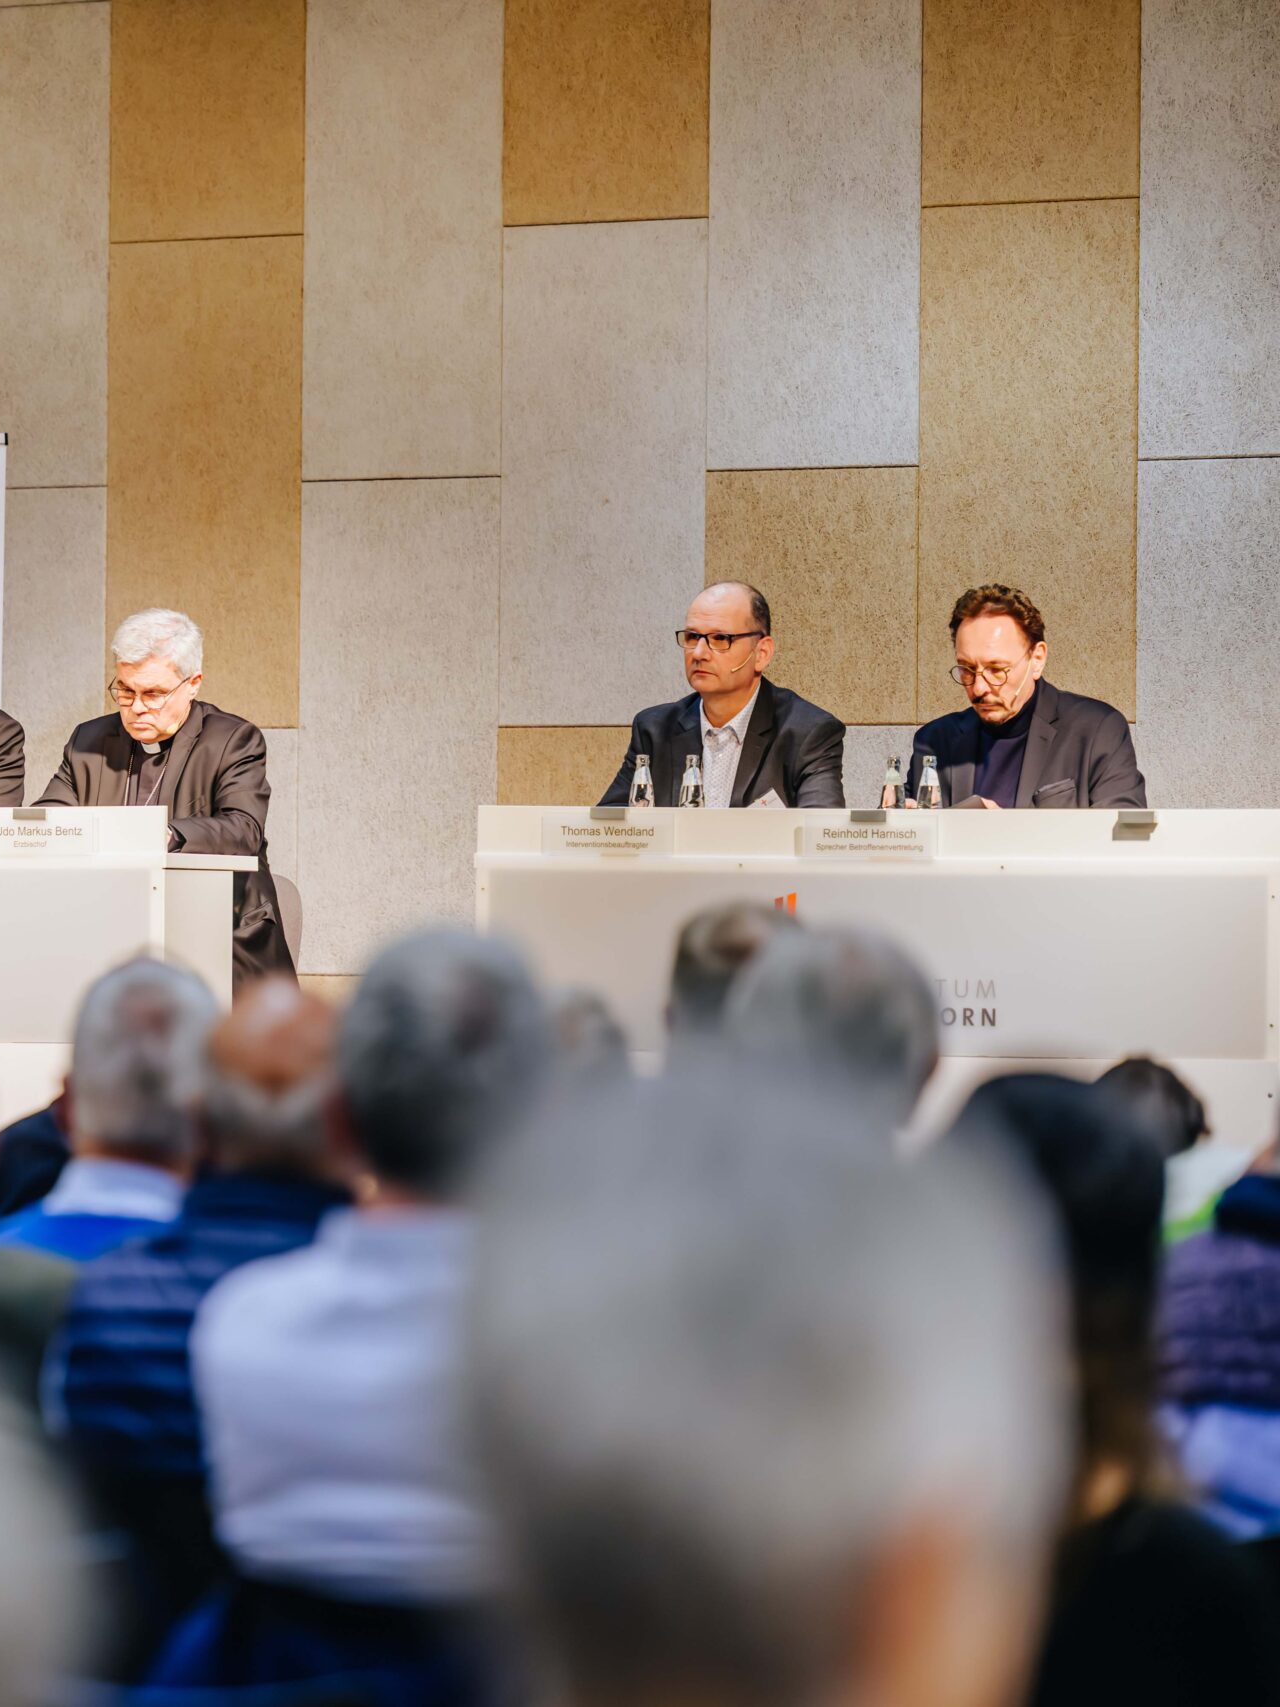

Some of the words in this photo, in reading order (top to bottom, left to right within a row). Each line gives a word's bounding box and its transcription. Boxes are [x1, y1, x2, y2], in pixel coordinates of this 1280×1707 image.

[17, 826, 53, 836] Markus
[55, 826, 83, 836] Bentz
[561, 826, 601, 836] Thomas
[604, 826, 655, 837] Wendland
[823, 828, 868, 839] Reinhold
[871, 828, 917, 839] Harnisch
[13, 840, 47, 848] Erzbischof
[815, 843, 847, 852] Sprecher
